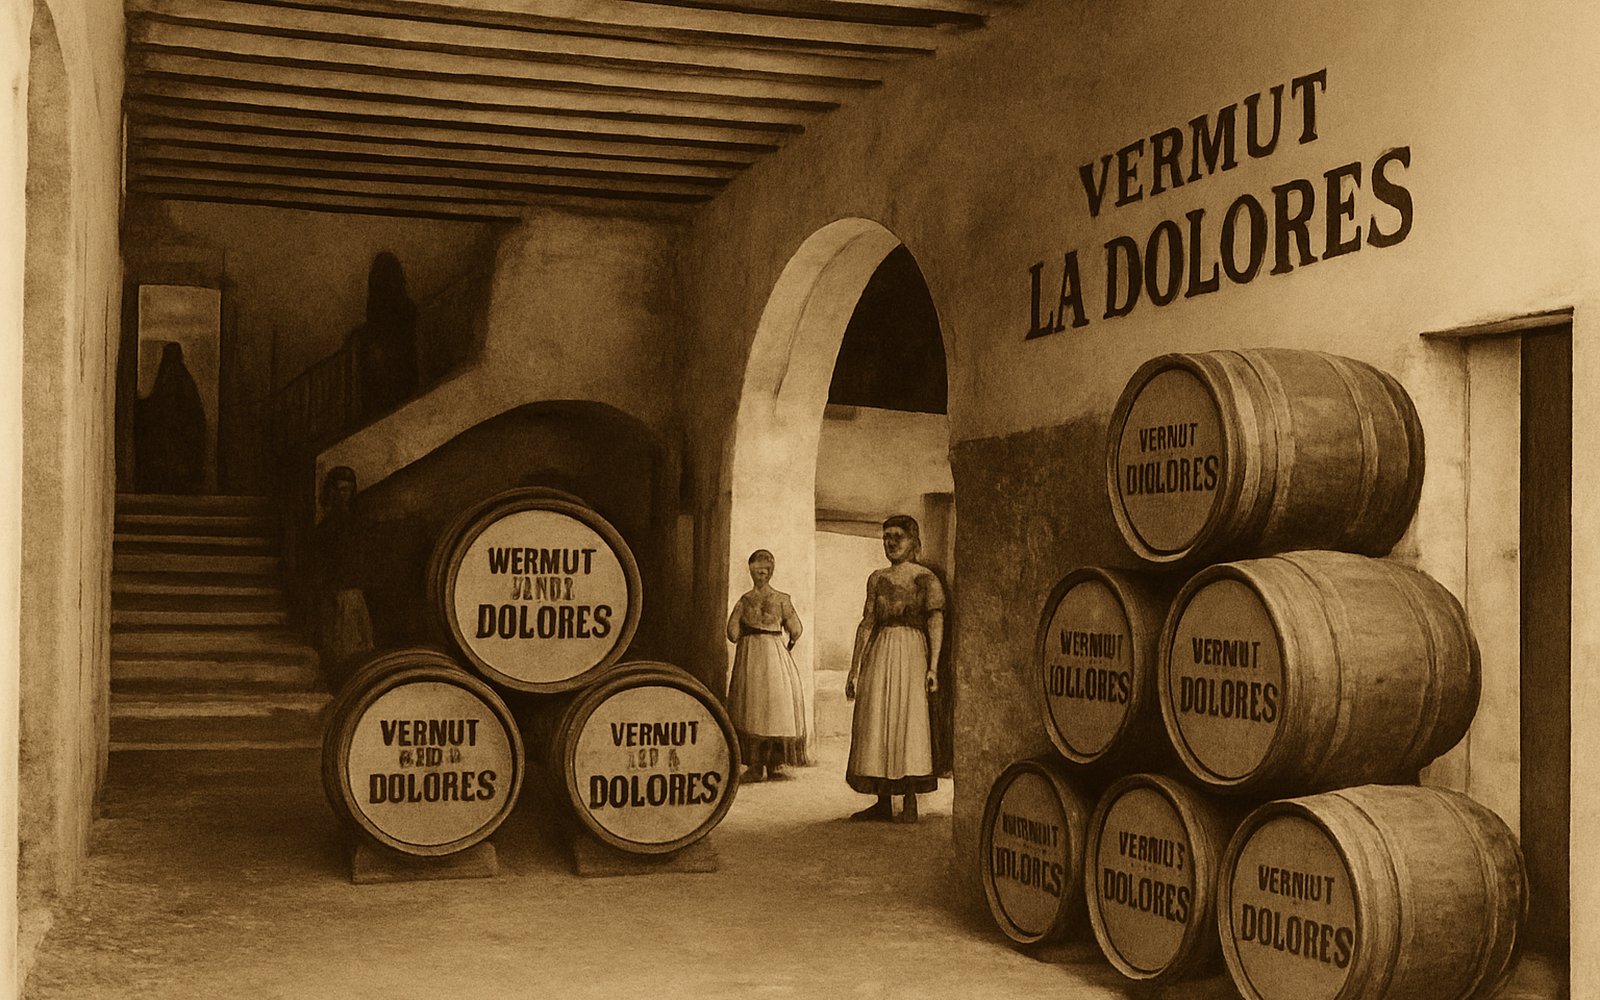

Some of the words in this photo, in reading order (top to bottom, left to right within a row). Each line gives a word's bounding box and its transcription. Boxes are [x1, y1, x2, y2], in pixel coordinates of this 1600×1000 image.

[1079, 68, 1327, 217] VERMUT
[1025, 250, 1090, 340] LA
[1103, 145, 1413, 320] DOLORES
[489, 547, 597, 575] WERMUT
[476, 604, 612, 639] DOLORES
[1180, 676, 1278, 723] DOLORES
[380, 719, 479, 746] VERNUT
[611, 721, 699, 747] VERNUT
[369, 770, 496, 804] DOLORES
[589, 771, 721, 809] DOLORES
[1104, 868, 1190, 924] DOLORES
[1241, 903, 1353, 969] DOLORES
